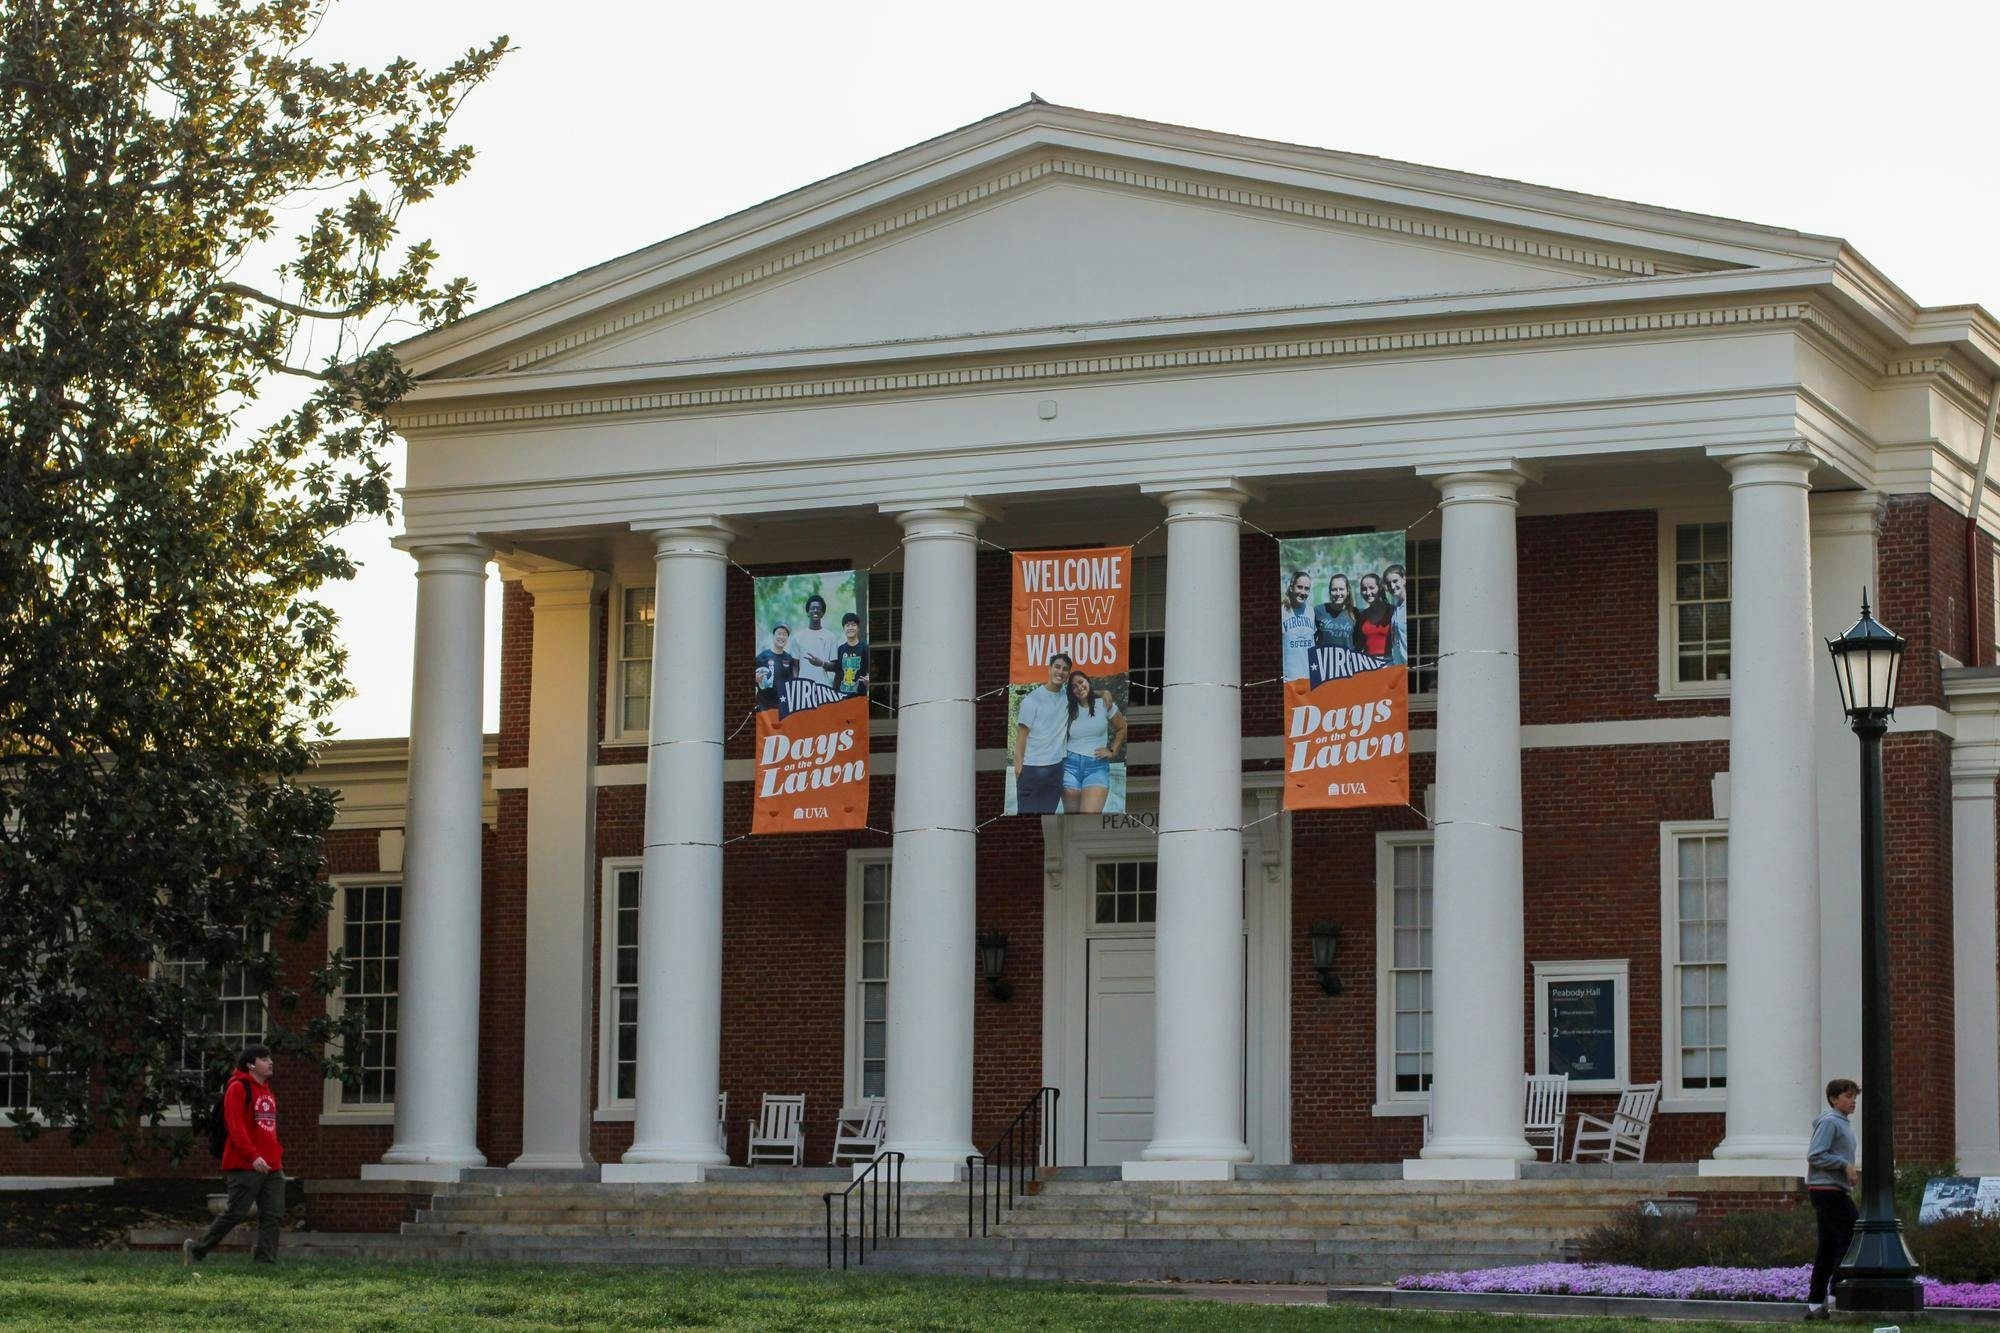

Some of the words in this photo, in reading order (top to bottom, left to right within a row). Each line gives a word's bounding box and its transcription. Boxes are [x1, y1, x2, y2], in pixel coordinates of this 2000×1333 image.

[1022, 556, 1122, 593] WELCOME
[1031, 595, 1115, 628] NEW
[1026, 631, 1117, 667] WAHOOS
[1288, 699, 1393, 738] Days
[760, 729, 854, 766] Days
[1315, 736, 1328, 744] on
[1331, 733, 1347, 741] the
[1289, 731, 1406, 773] Lawn
[798, 760, 813, 768] the
[759, 760, 866, 798] Lawn
[1341, 782, 1367, 795] UVA
[805, 807, 829, 819] UVA
[1553, 988, 1585, 998] Peabody
[1586, 988, 1601, 996] Hall
[1553, 1008, 1558, 1018] 1
[1553, 1027, 1559, 1038] 2
